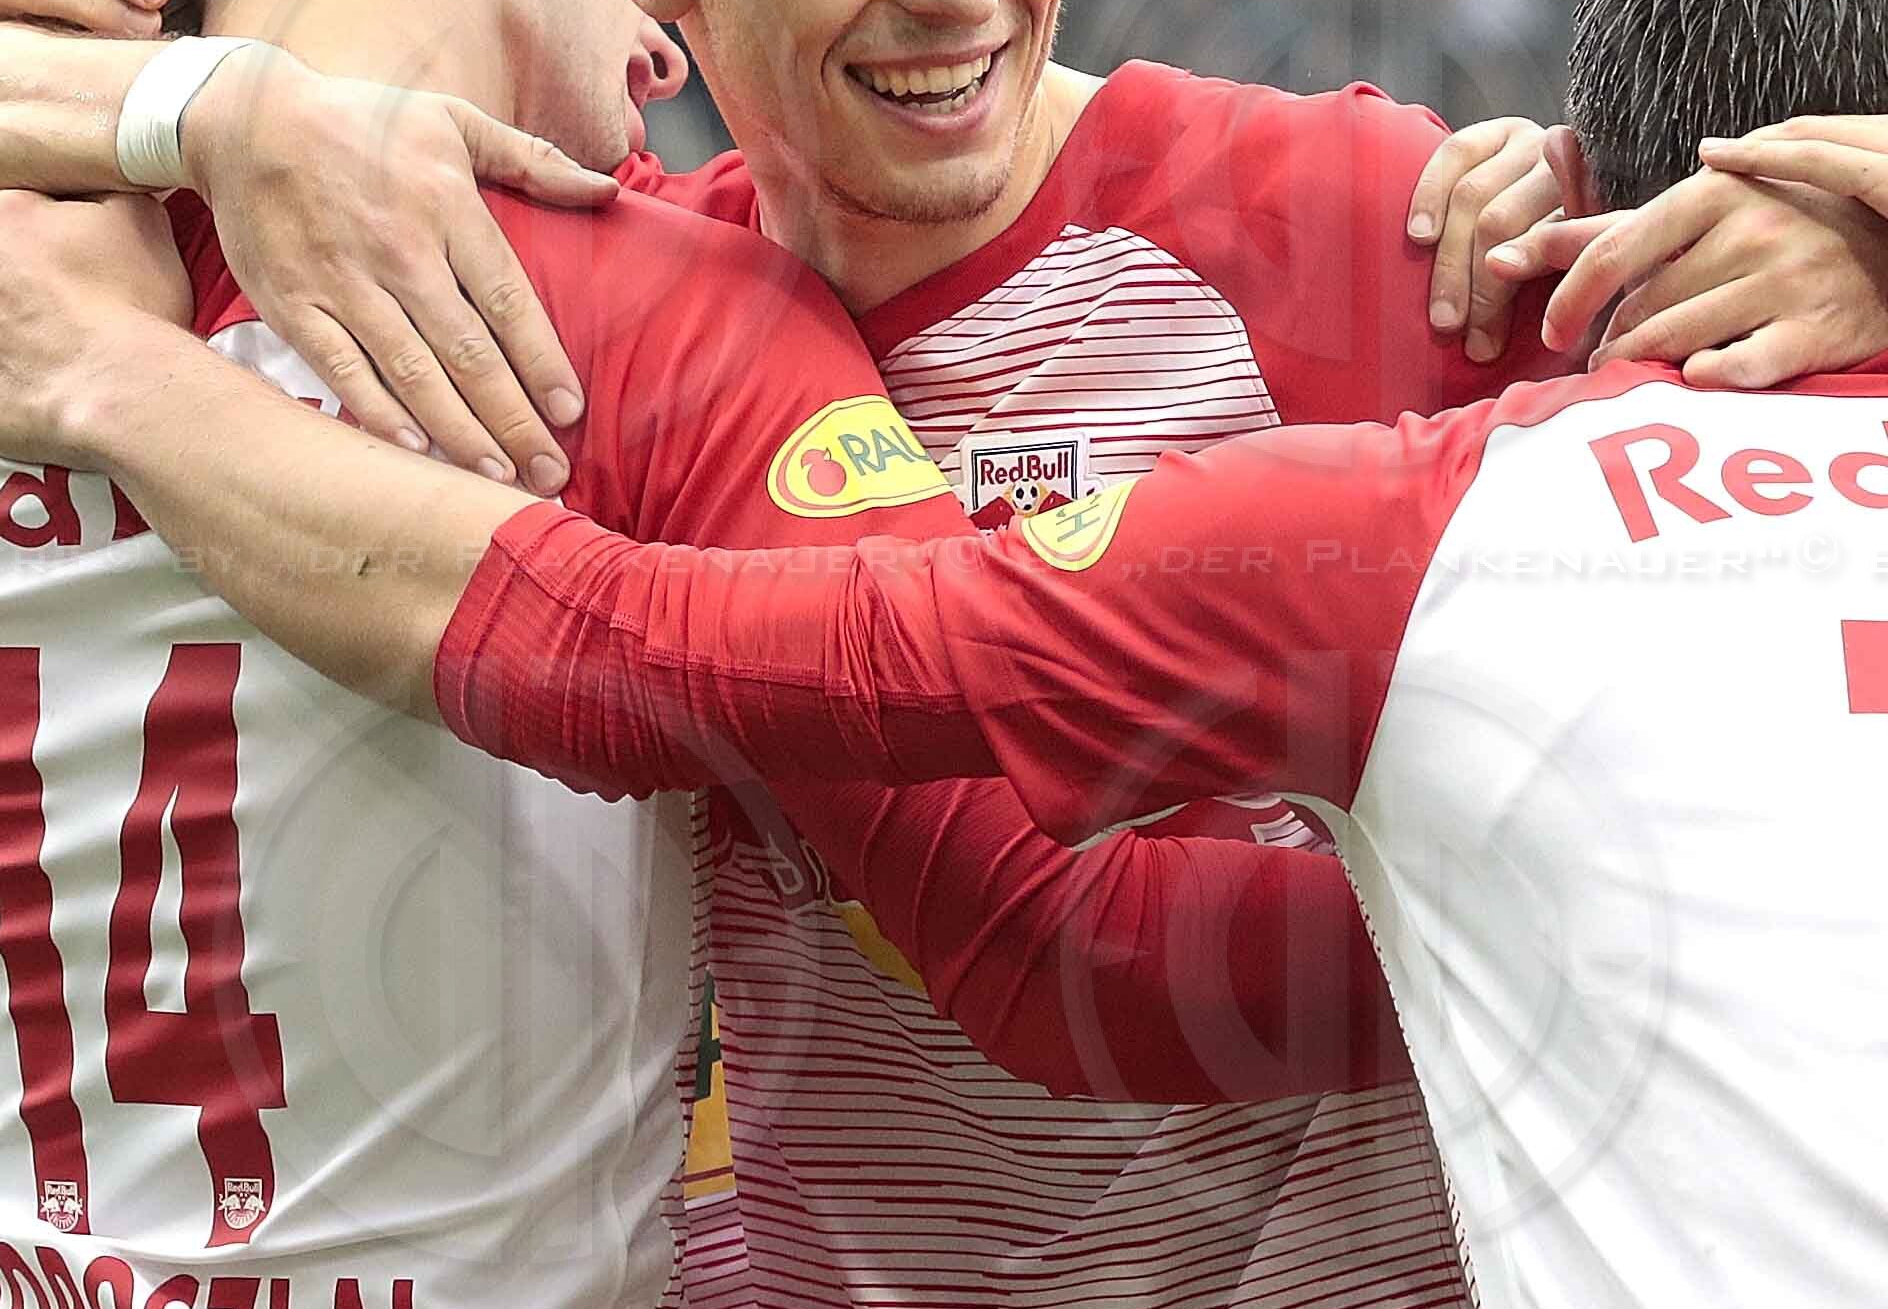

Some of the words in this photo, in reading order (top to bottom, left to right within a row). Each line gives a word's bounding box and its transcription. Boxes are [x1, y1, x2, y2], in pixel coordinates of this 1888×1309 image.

[838, 425, 931, 476] RAU
[980, 458, 1023, 486] Red
[1026, 451, 1069, 481] Bull
